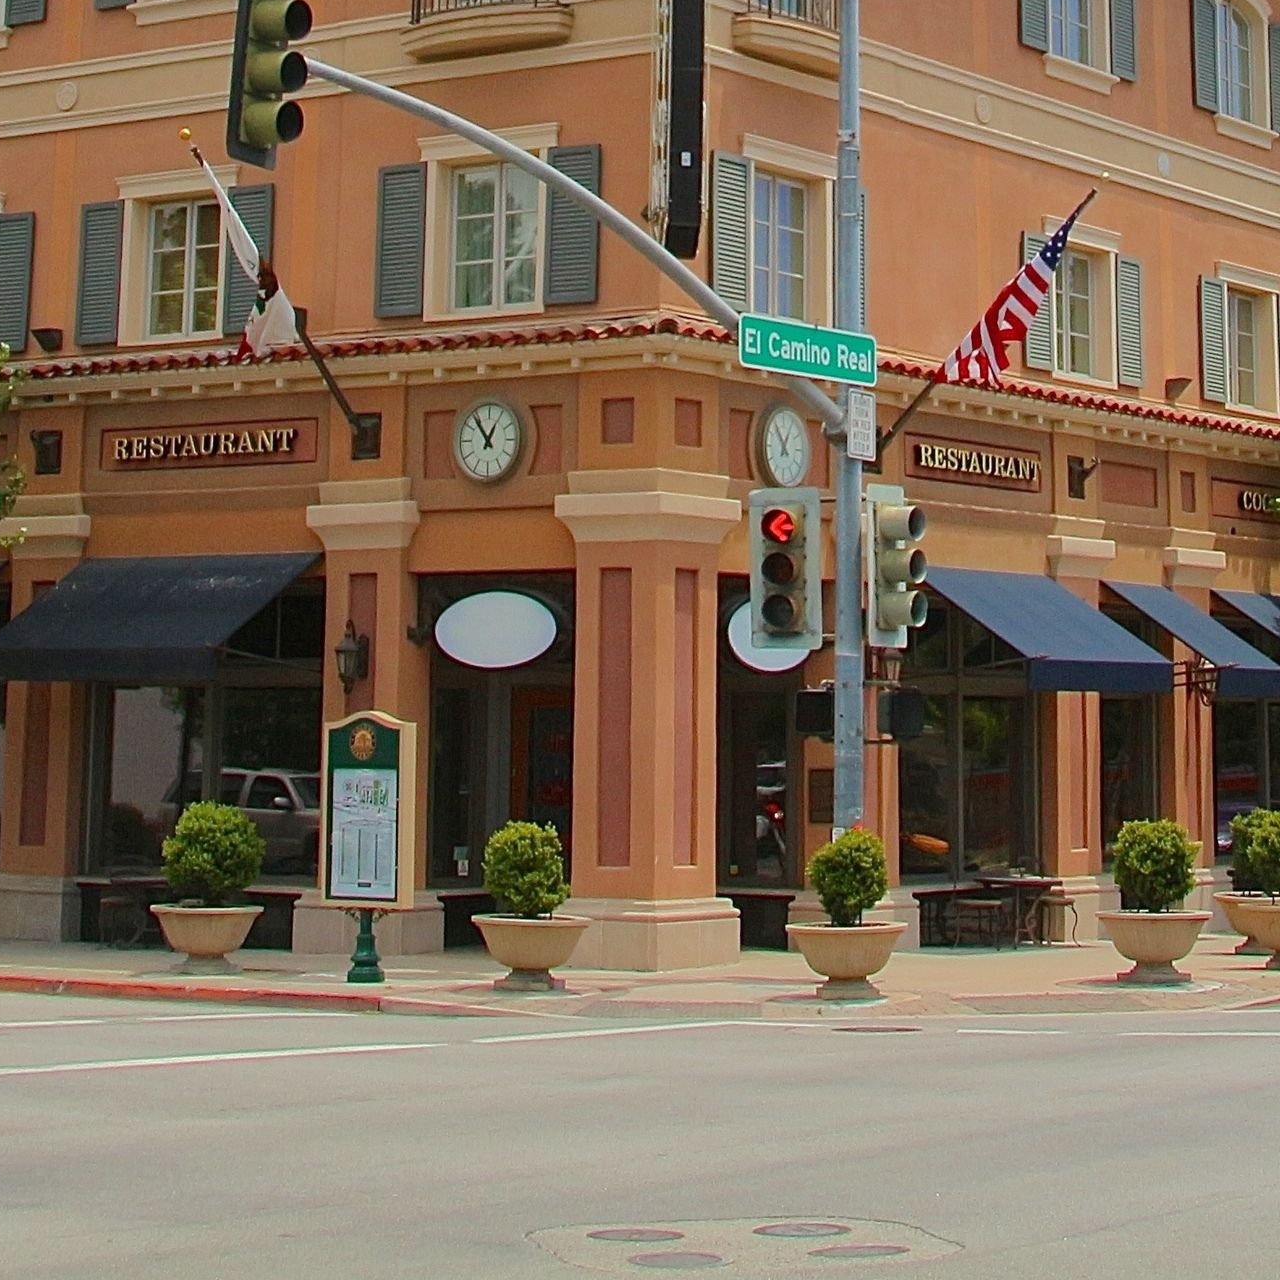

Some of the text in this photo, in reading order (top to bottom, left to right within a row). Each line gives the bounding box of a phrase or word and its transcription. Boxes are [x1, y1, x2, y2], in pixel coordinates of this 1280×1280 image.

[745, 328, 872, 373] El Camino Real
[113, 428, 294, 460] RESTAURANT
[920, 443, 1041, 480] RESTAURANT
